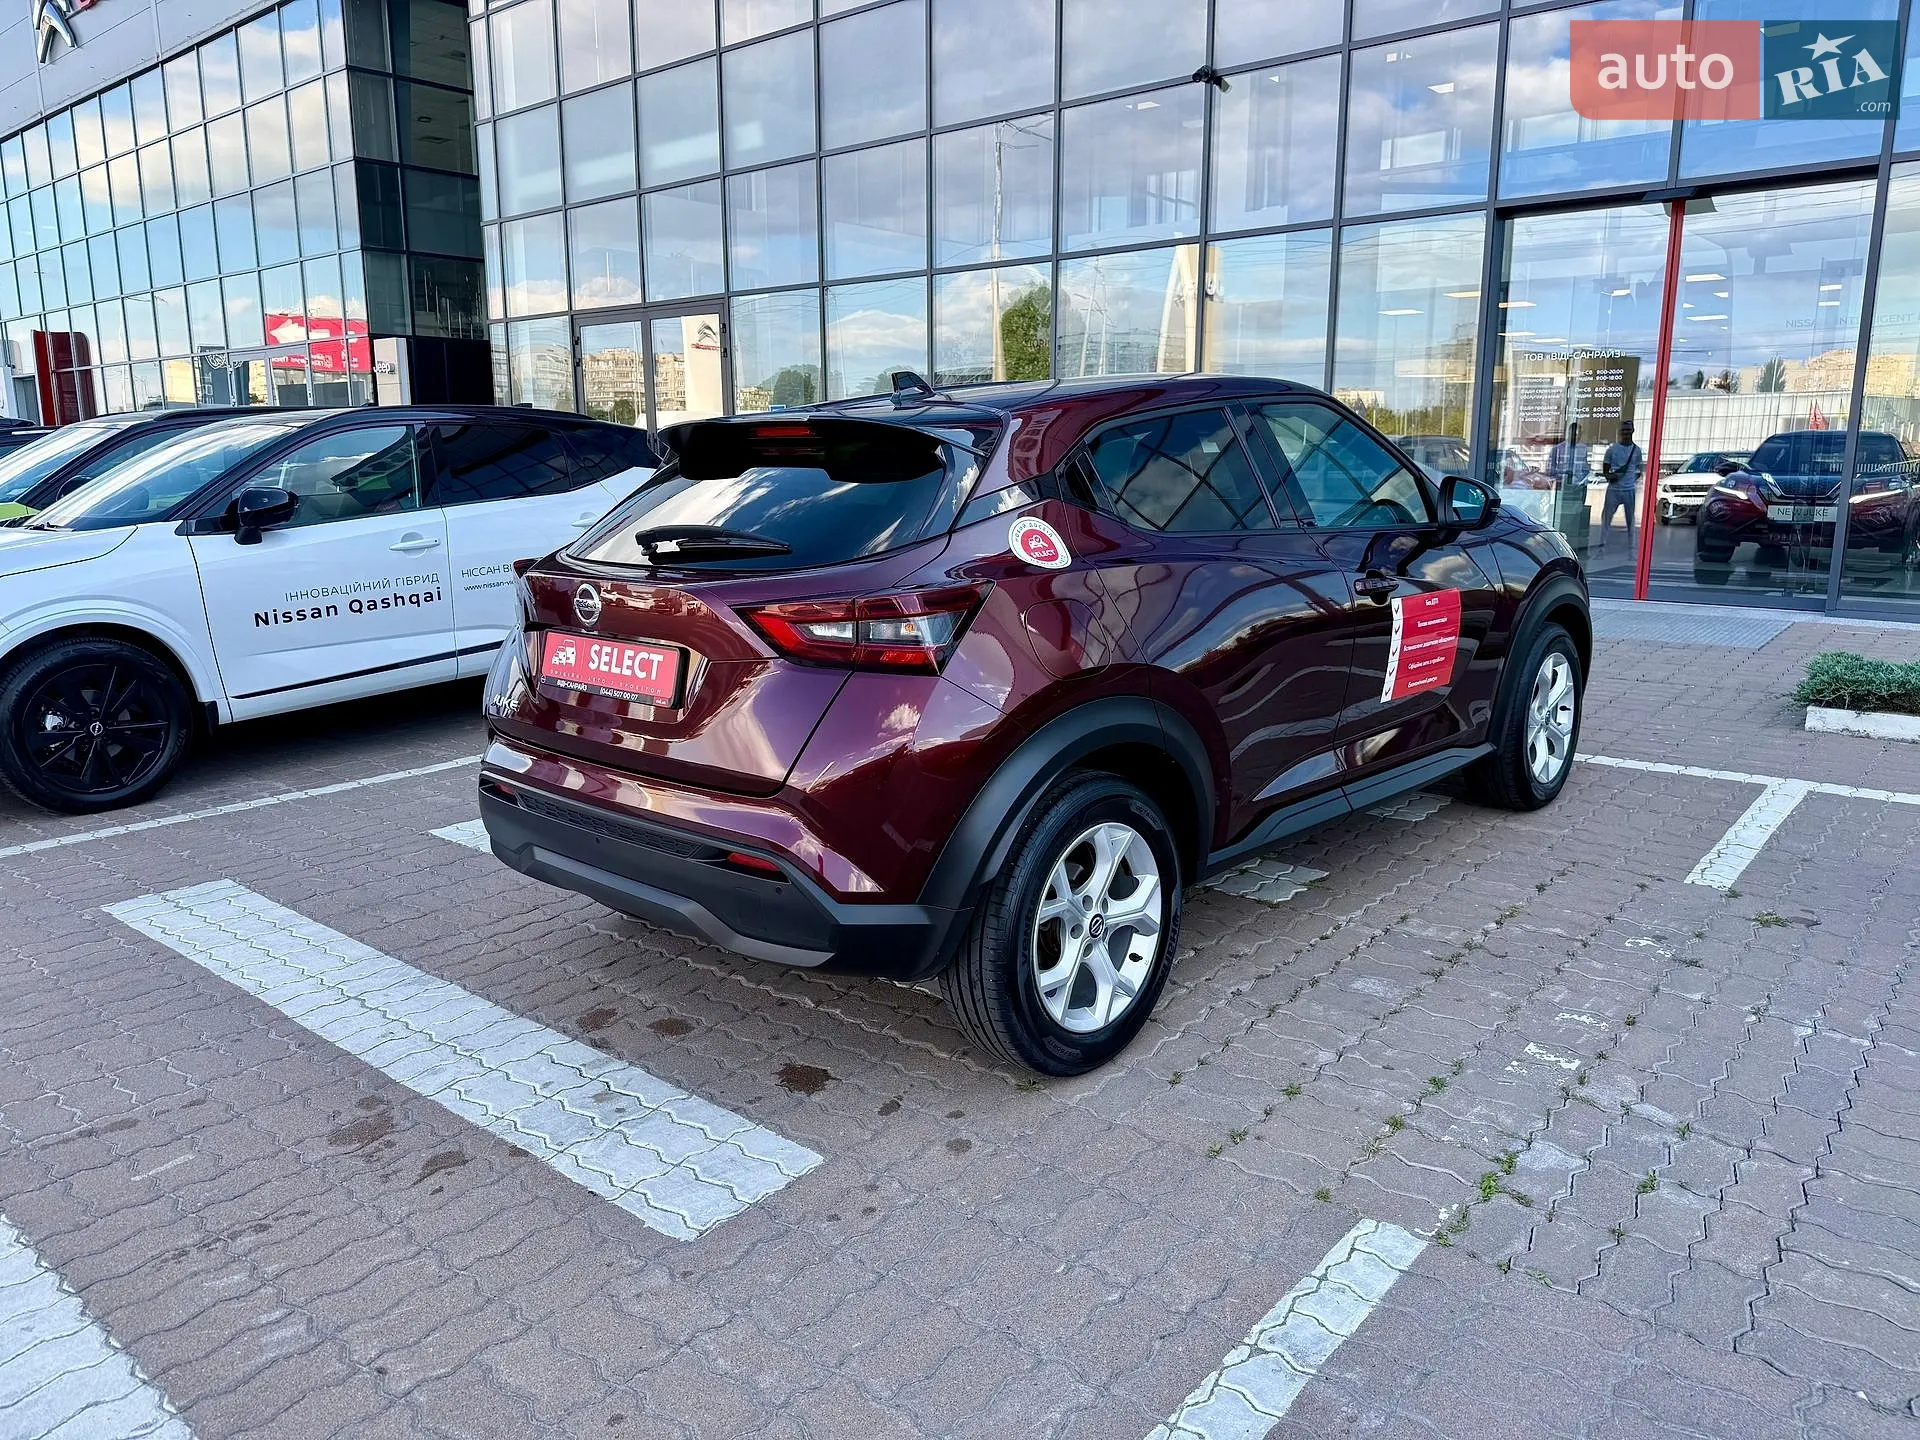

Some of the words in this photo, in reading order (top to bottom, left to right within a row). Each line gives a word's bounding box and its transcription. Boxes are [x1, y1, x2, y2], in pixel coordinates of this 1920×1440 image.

[1524, 353, 1544, 361] ТОВ
[373, 362, 391, 374] Jeep
[1777, 507, 1803, 517] NEW
[1804, 507, 1829, 517] JUKE
[1030, 549, 1056, 559] SELECT
[461, 565, 501, 578] НІССАН
[285, 577, 392, 602] ІННОВАЦІЙНИЙ
[395, 572, 440, 587] ГІБРИД
[254, 603, 339, 628] Nissan
[348, 586, 443, 615] Qashqai
[588, 643, 664, 681] SELECT
[600, 686, 614, 697] (044)
[613, 689, 623, 697] 507
[491, 694, 519, 712] JUKE
